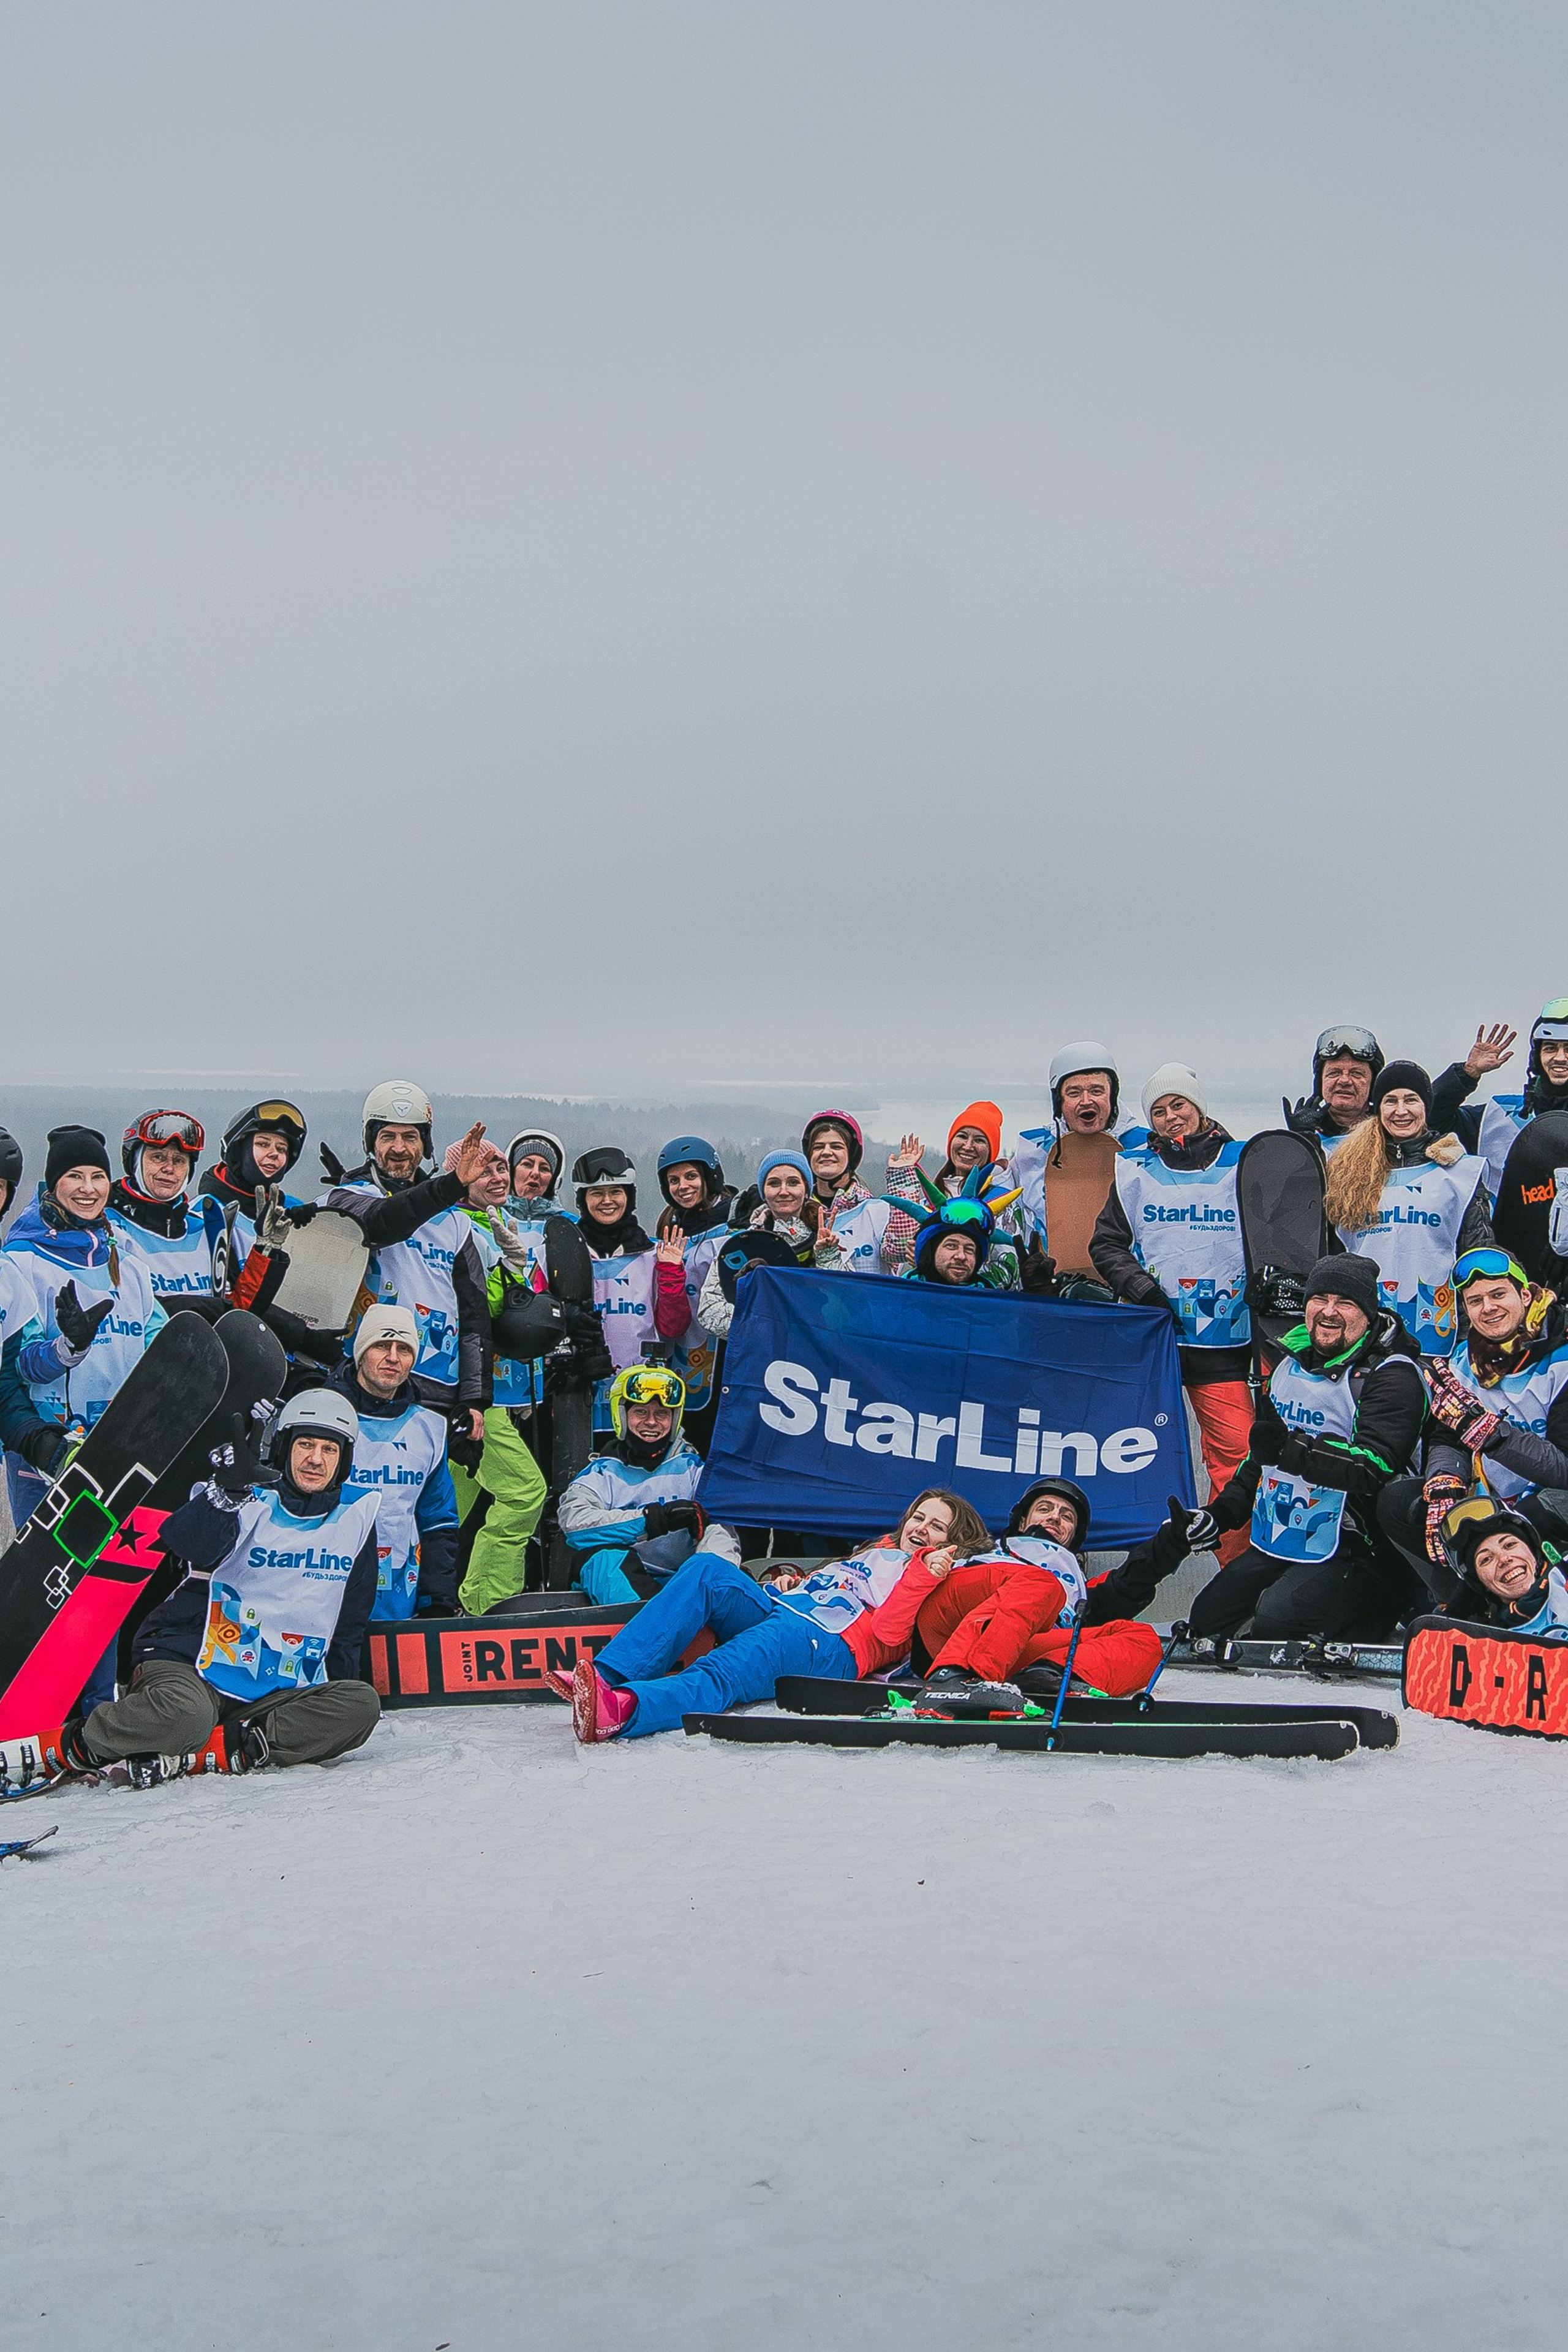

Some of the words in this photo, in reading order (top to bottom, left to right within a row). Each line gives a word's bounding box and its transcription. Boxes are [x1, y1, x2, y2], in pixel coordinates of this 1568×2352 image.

[1521, 1178, 1554, 1205] head
[1143, 1204, 1235, 1223] StarLine
[151, 1272, 212, 1292] StarLin
[350, 1464, 424, 1486] tarLine
[247, 1547, 353, 1572] StarLine
[461, 1642, 473, 1683] JOINT
[924, 1692, 971, 1700] TECNICA
